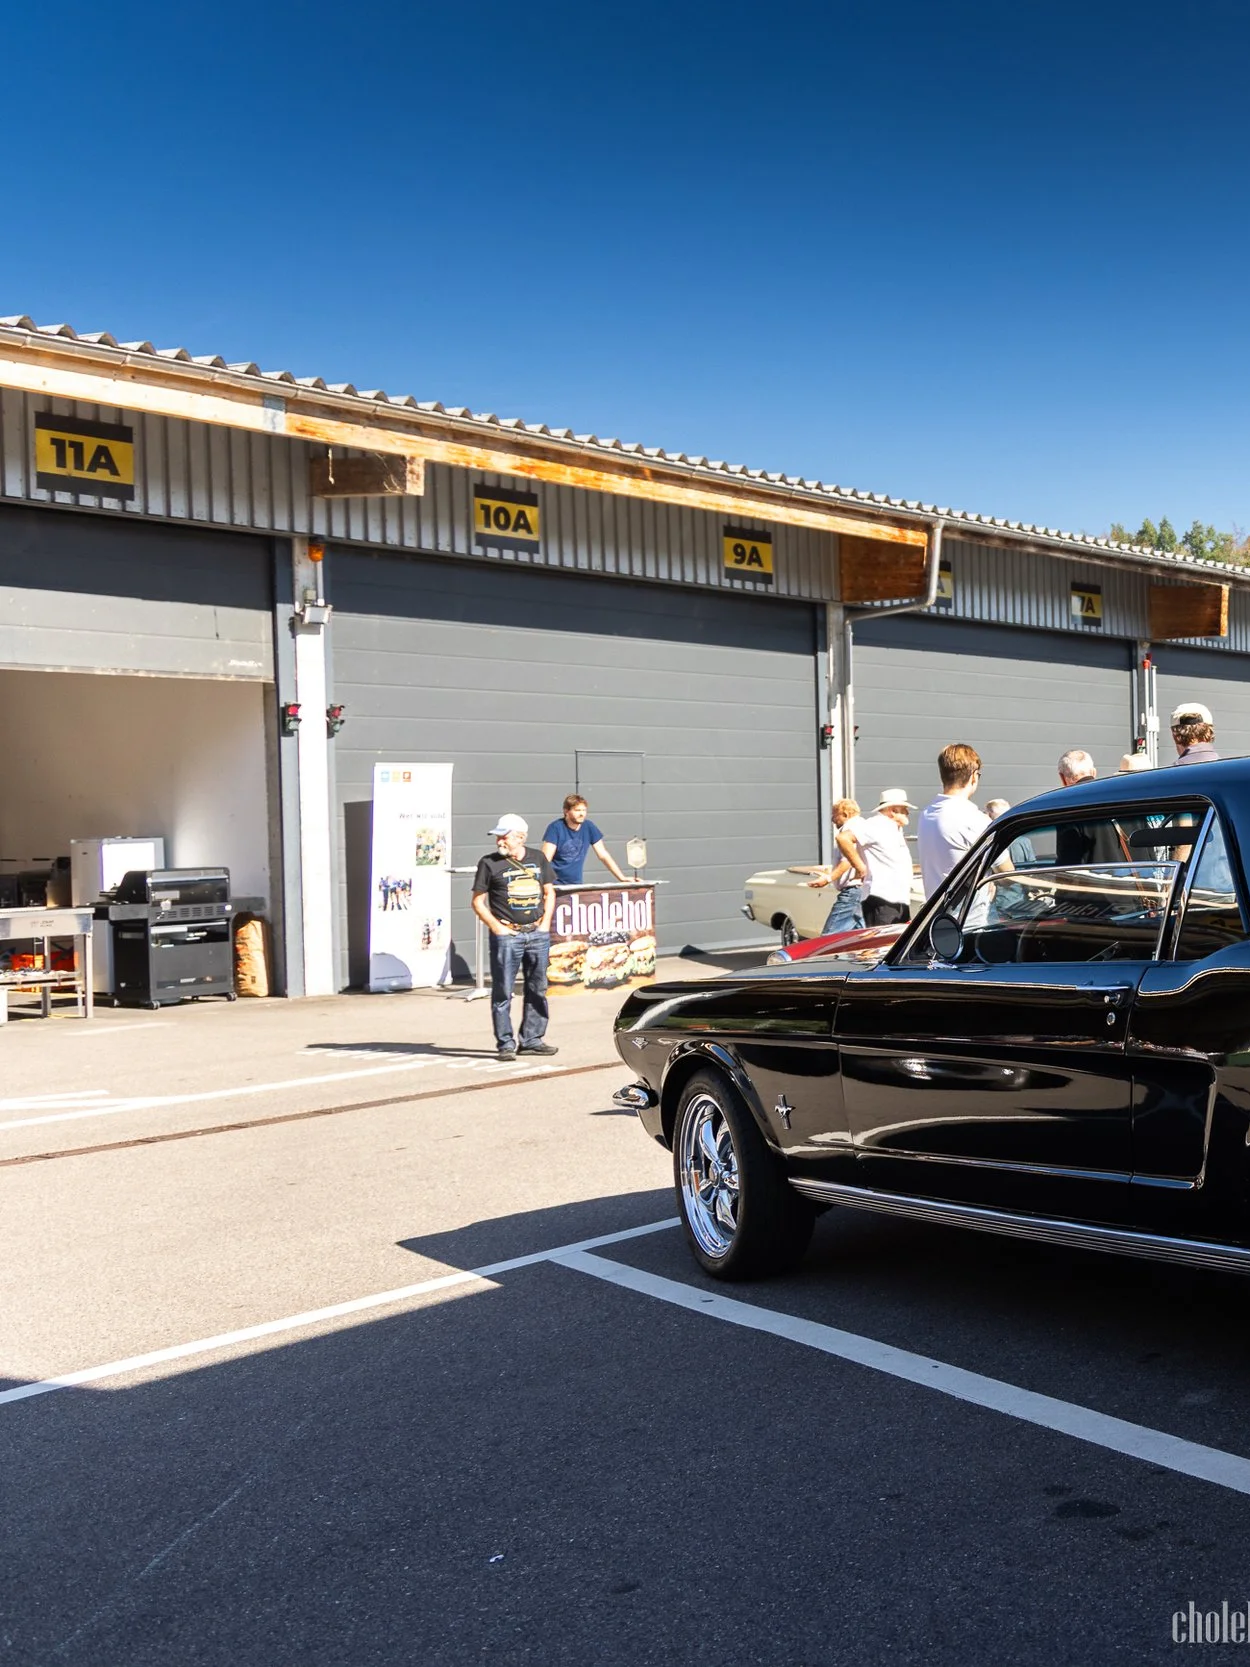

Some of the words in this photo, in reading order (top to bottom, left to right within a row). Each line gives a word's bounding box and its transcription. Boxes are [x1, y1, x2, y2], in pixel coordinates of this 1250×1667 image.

[50, 437, 121, 477] 11A
[480, 503, 534, 535] 10A
[733, 542, 764, 568] 9A
[556, 889, 653, 936] cholehof
